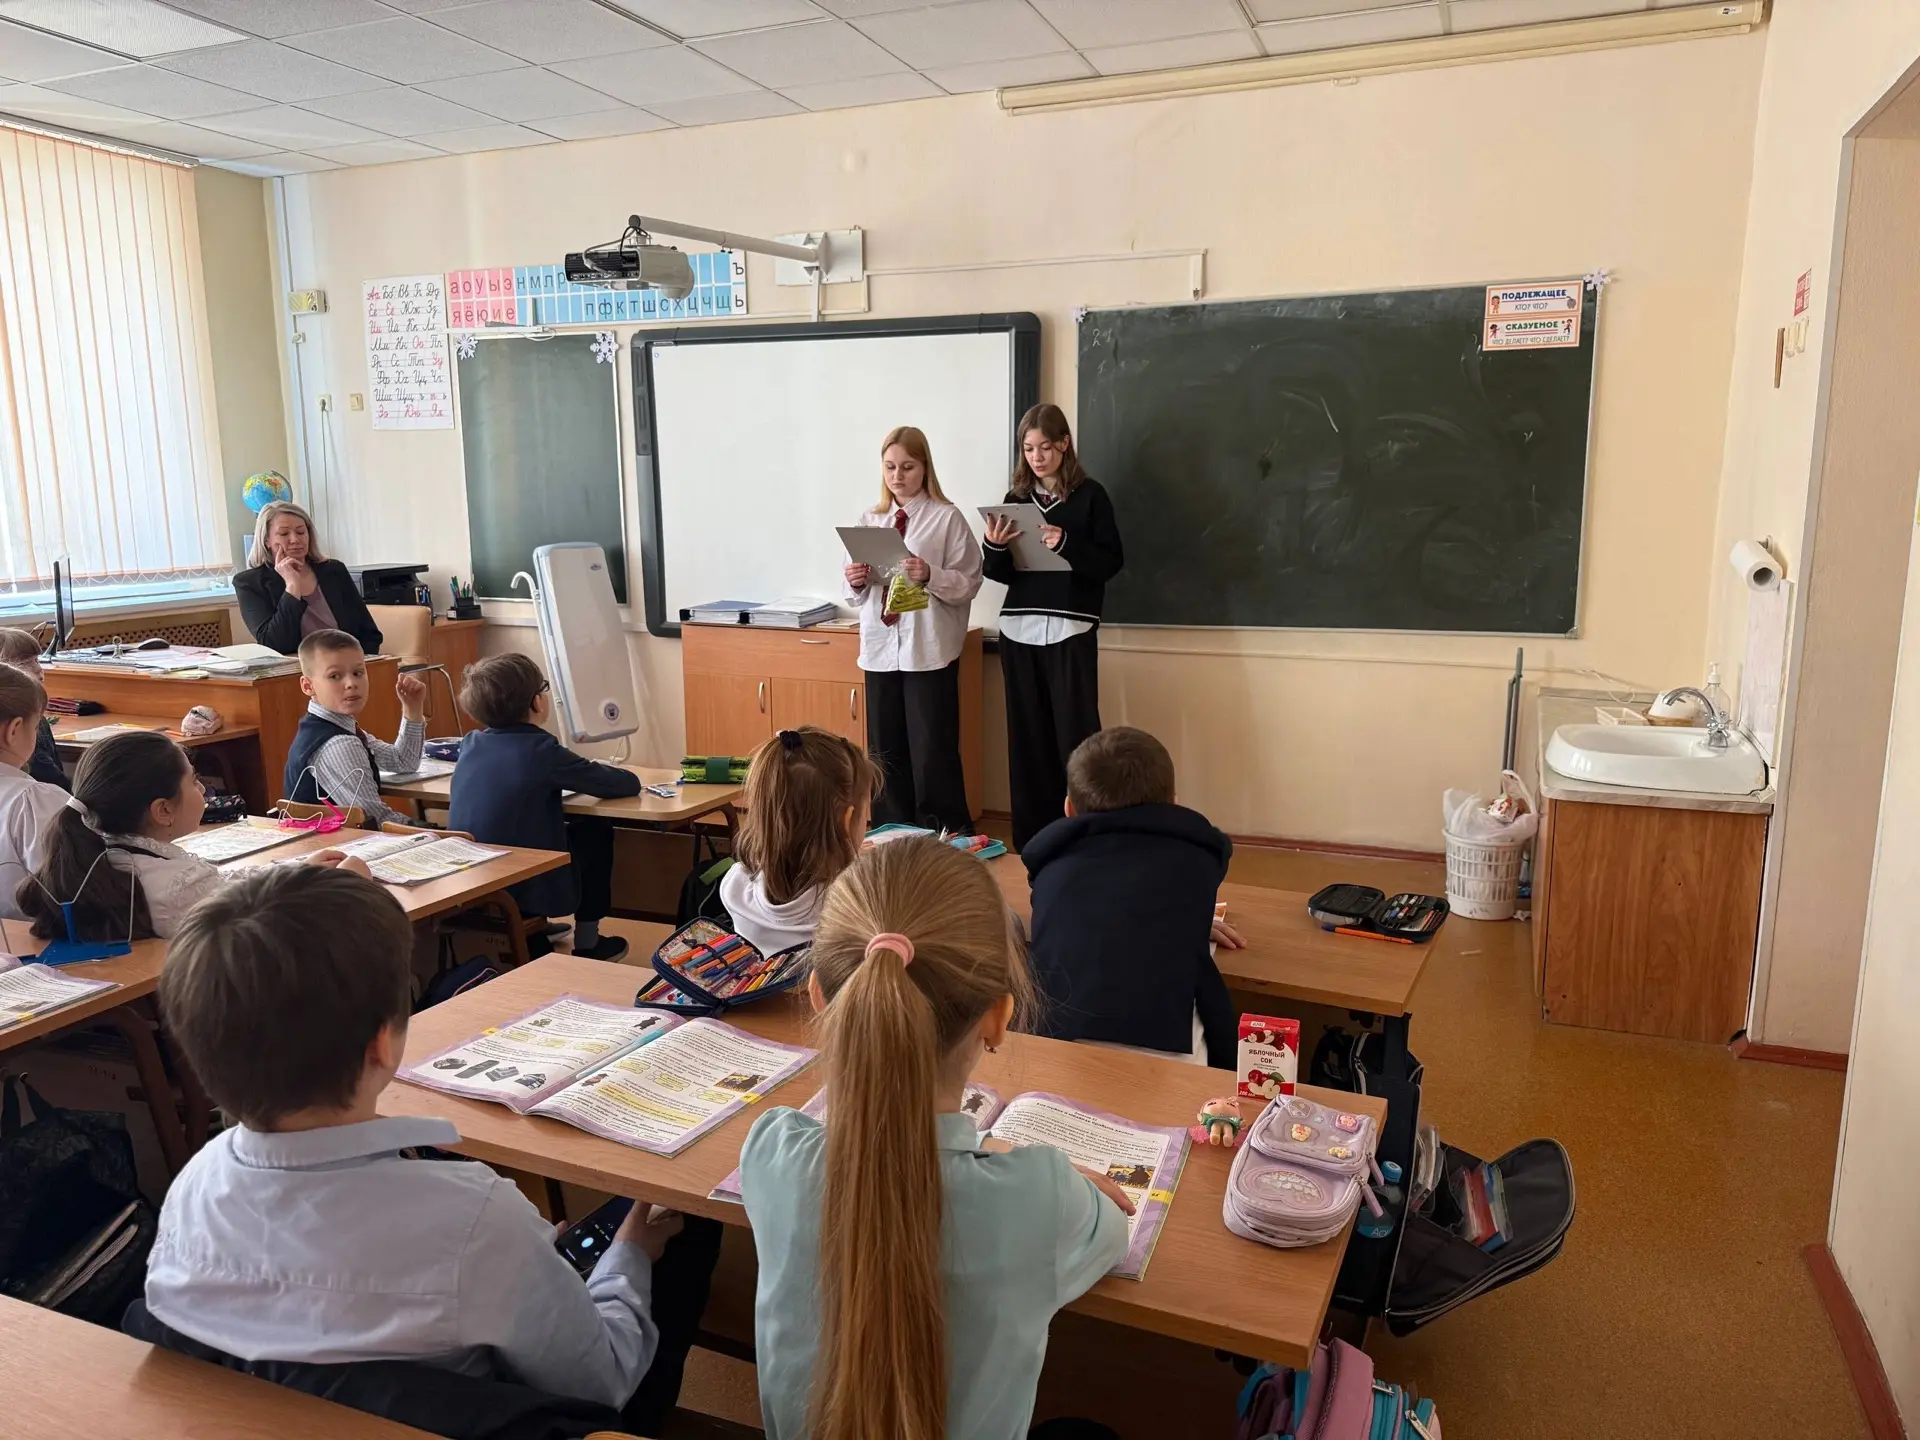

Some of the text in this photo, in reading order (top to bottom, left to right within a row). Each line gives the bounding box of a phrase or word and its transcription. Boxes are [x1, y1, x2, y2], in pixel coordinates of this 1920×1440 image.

[489, 279, 500, 292] ы
[1502, 289, 1566, 300] ПОДЛЕЖАЩЕЕ
[1506, 321, 1558, 331] СКАЗУЕМОЕ
[1248, 1049, 1285, 1058] ЯБЛОЧНЫЙ
